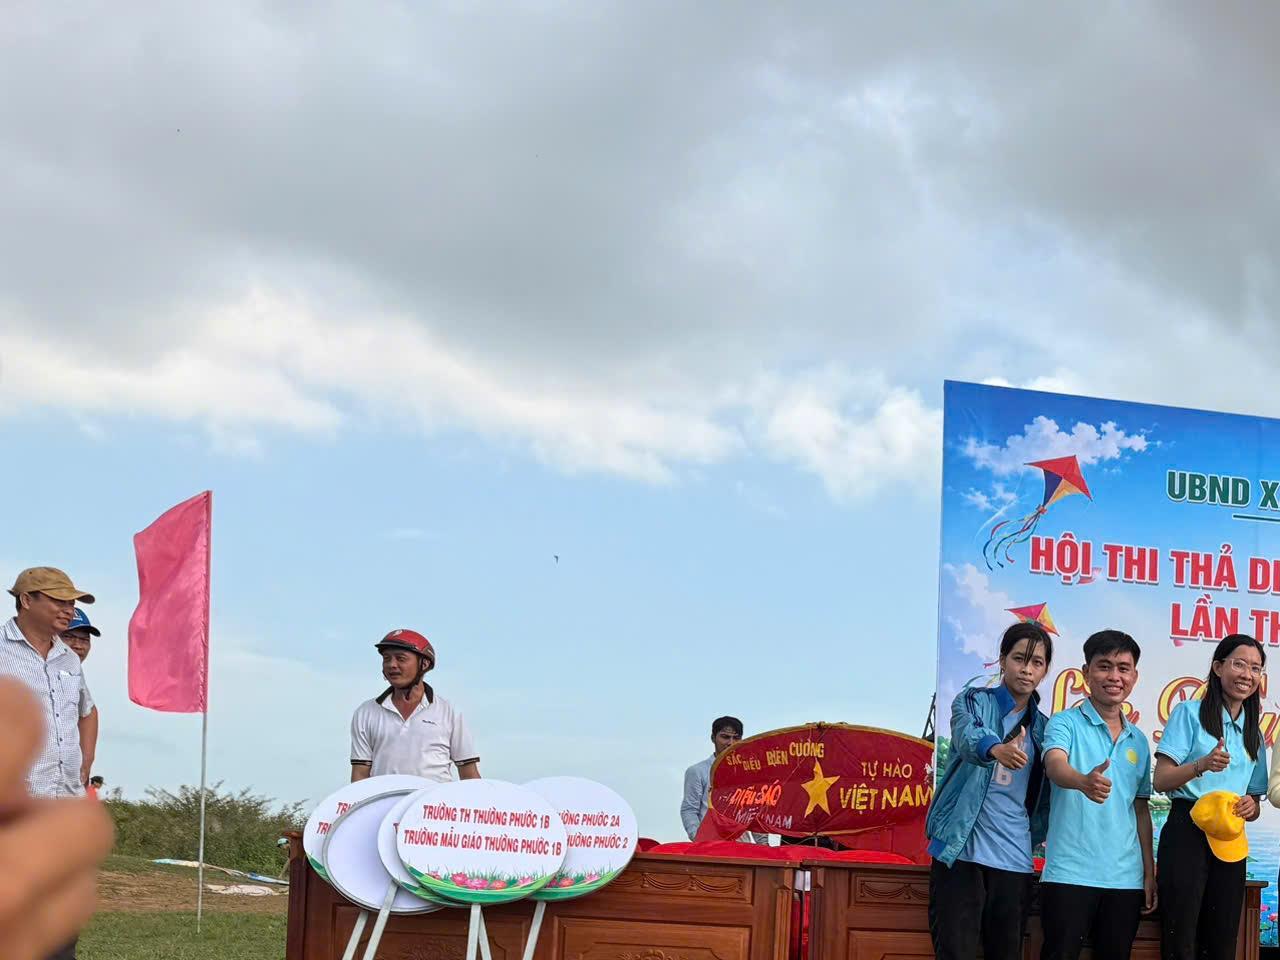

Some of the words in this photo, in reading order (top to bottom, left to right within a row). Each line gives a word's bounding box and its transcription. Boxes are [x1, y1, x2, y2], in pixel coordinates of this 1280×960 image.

[1167, 470, 1250, 506] UBND
[1030, 532, 1092, 584] HỘI
[1103, 544, 1159, 582] THI
[1169, 543, 1238, 589] THẢ
[1170, 593, 1239, 641] LẦN
[861, 760, 878, 781] TỰ
[883, 757, 913, 778] HÀO
[840, 783, 878, 814] VIỆT
[881, 785, 934, 810] NAM
[423, 801, 457, 821] TRƯỜNG
[460, 808, 474, 823] TH
[473, 806, 507, 826] THƯỜNG
[509, 810, 537, 829] PHƯỚC
[540, 815, 550, 829] 1B
[581, 811, 609, 827] PHƯỚC
[610, 815, 620, 827] 2A
[404, 826, 438, 846] TRƯỜNG
[461, 831, 482, 850] GIÁO
[484, 833, 519, 853] THƯỜNG
[520, 836, 549, 855] PHƯỚC
[551, 841, 562, 856] 1B
[593, 833, 620, 849] PHƯỚC
[622, 837, 629, 849] 2
